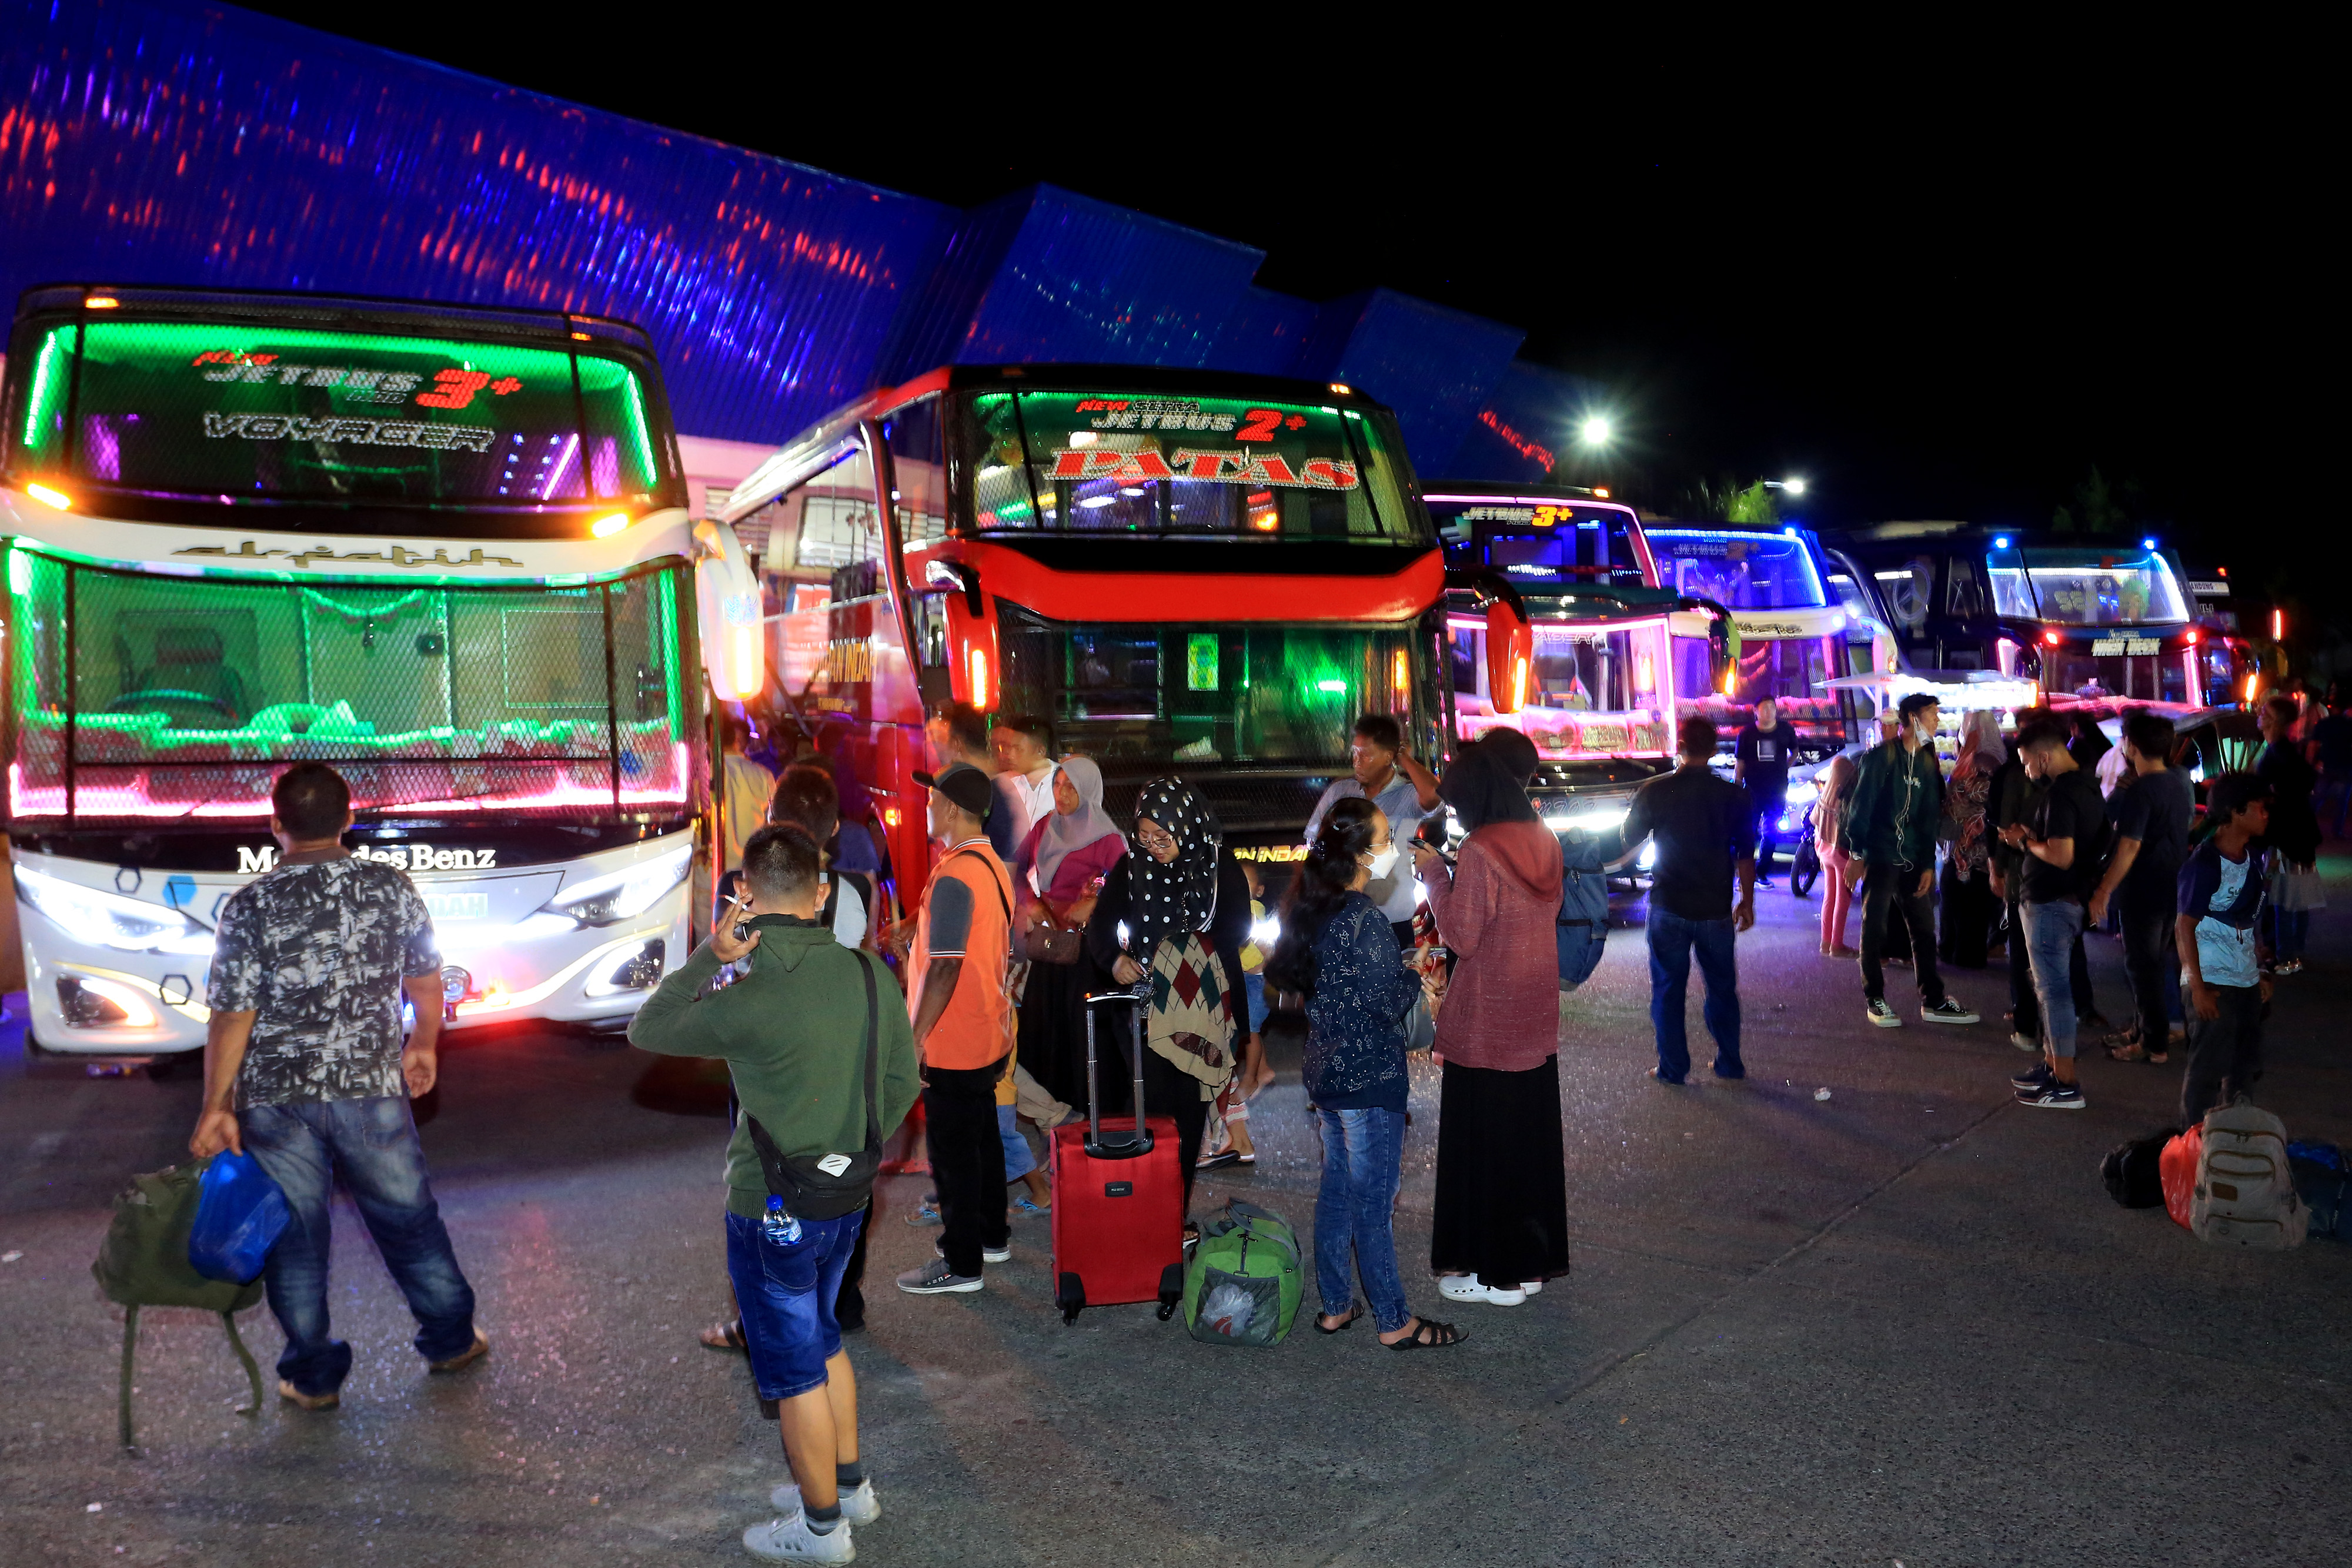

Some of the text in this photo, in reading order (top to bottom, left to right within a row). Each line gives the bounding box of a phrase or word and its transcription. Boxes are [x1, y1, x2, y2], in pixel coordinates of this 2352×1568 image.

[1075, 399, 1130, 413] NEW
[203, 411, 496, 453] VOYAGER
[1091, 407, 1308, 441] JETBUS 2+
[1043, 447, 1359, 490] PATAS
[1462, 506, 1573, 527] JETBUS 3+
[237, 844, 496, 874] Mdes Benz
[425, 893, 489, 920] DAH
